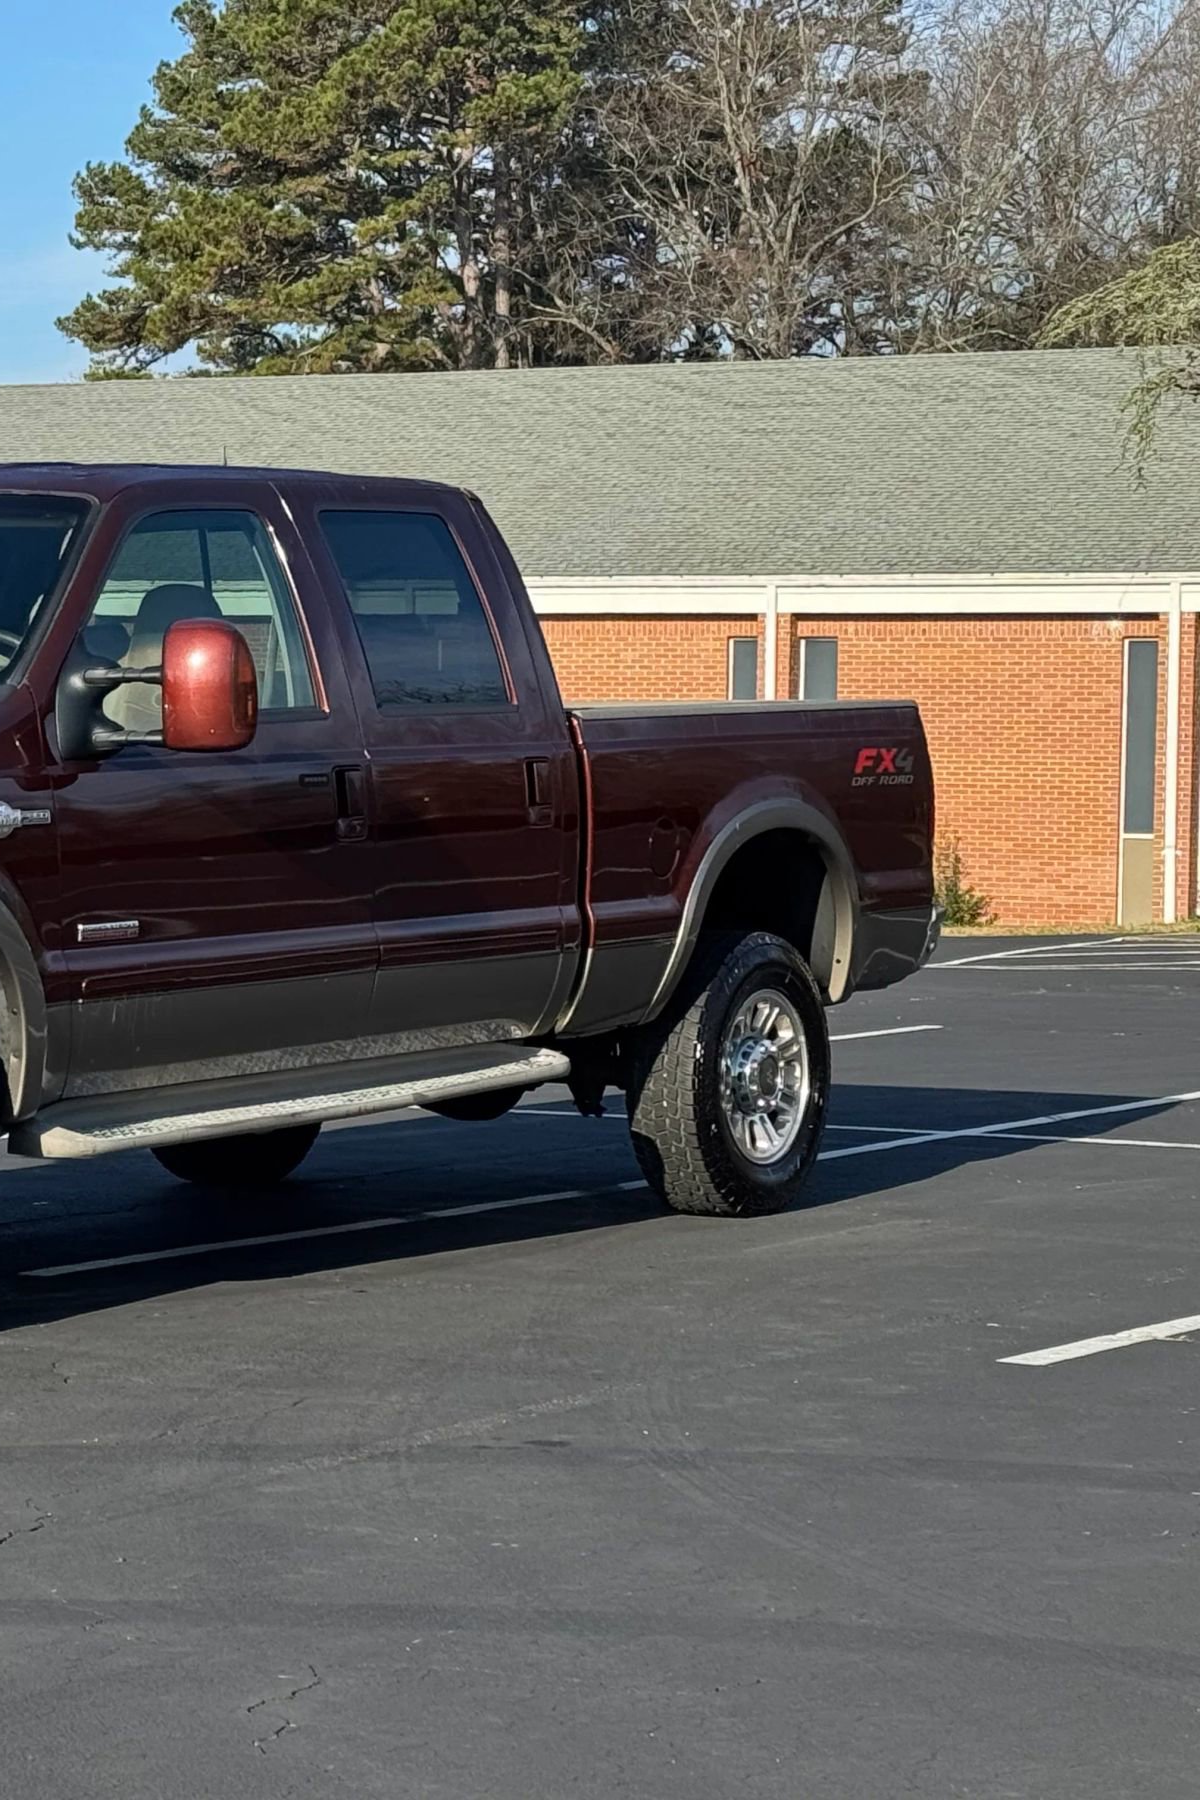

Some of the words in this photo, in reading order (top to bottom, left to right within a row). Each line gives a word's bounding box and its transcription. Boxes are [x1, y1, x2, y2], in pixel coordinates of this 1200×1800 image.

[854, 748, 914, 774] FX4
[851, 776, 877, 787] OFF
[879, 774, 914, 785] ROAD
